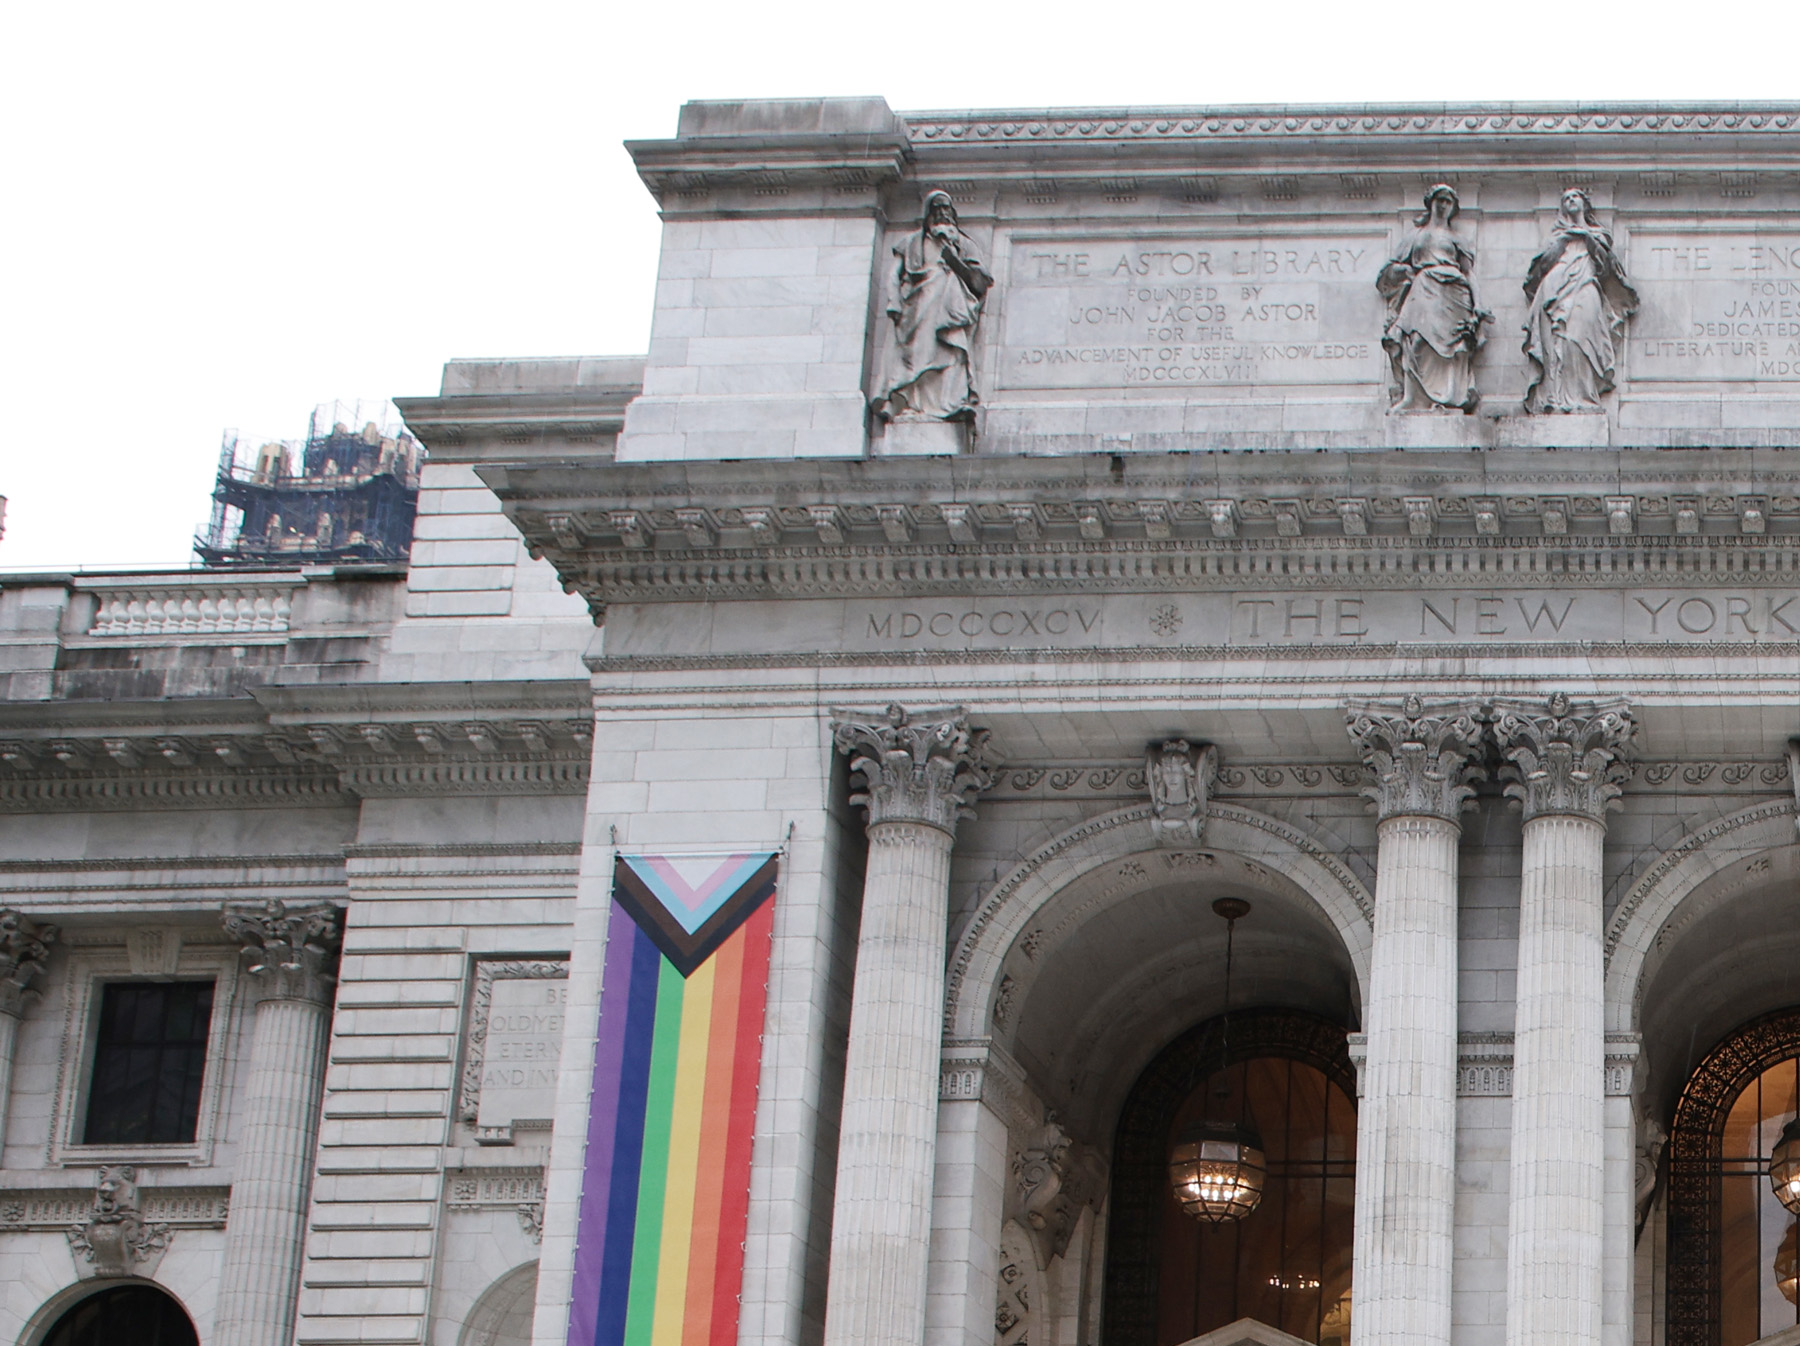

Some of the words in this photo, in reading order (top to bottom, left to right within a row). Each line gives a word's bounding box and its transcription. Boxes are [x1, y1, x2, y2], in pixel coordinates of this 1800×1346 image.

[1032, 253, 1090, 277] THE
[1113, 252, 1214, 276] ASTOR
[1232, 250, 1365, 275] LIBRARY
[1651, 247, 1711, 271] THE
[1128, 288, 1218, 302] FOUNDED
[1241, 287, 1263, 300] BY
[1069, 307, 1135, 325] JOHN
[1148, 306, 1226, 323] JACOB
[1241, 304, 1318, 322] ASTOR
[1147, 328, 1184, 341] FOR
[1197, 327, 1234, 340] THE
[1695, 323, 1800, 336] DEDICATED
[1019, 348, 1153, 364] ADVANCEMENT
[1159, 347, 1182, 361] OF
[1190, 346, 1254, 361] USEFUL
[1261, 344, 1368, 361] KNOWLEDGE
[1645, 342, 1768, 357] LITERATURE
[1123, 364, 1258, 382] MDCCCXLVIII
[865, 609, 1102, 639] MDCCCXCV
[1237, 599, 1370, 639] THE
[1415, 597, 1576, 635] NEW
[1631, 597, 1800, 636] YORK
[491, 1015, 531, 1031] OLD
[483, 1069, 525, 1086] AND
